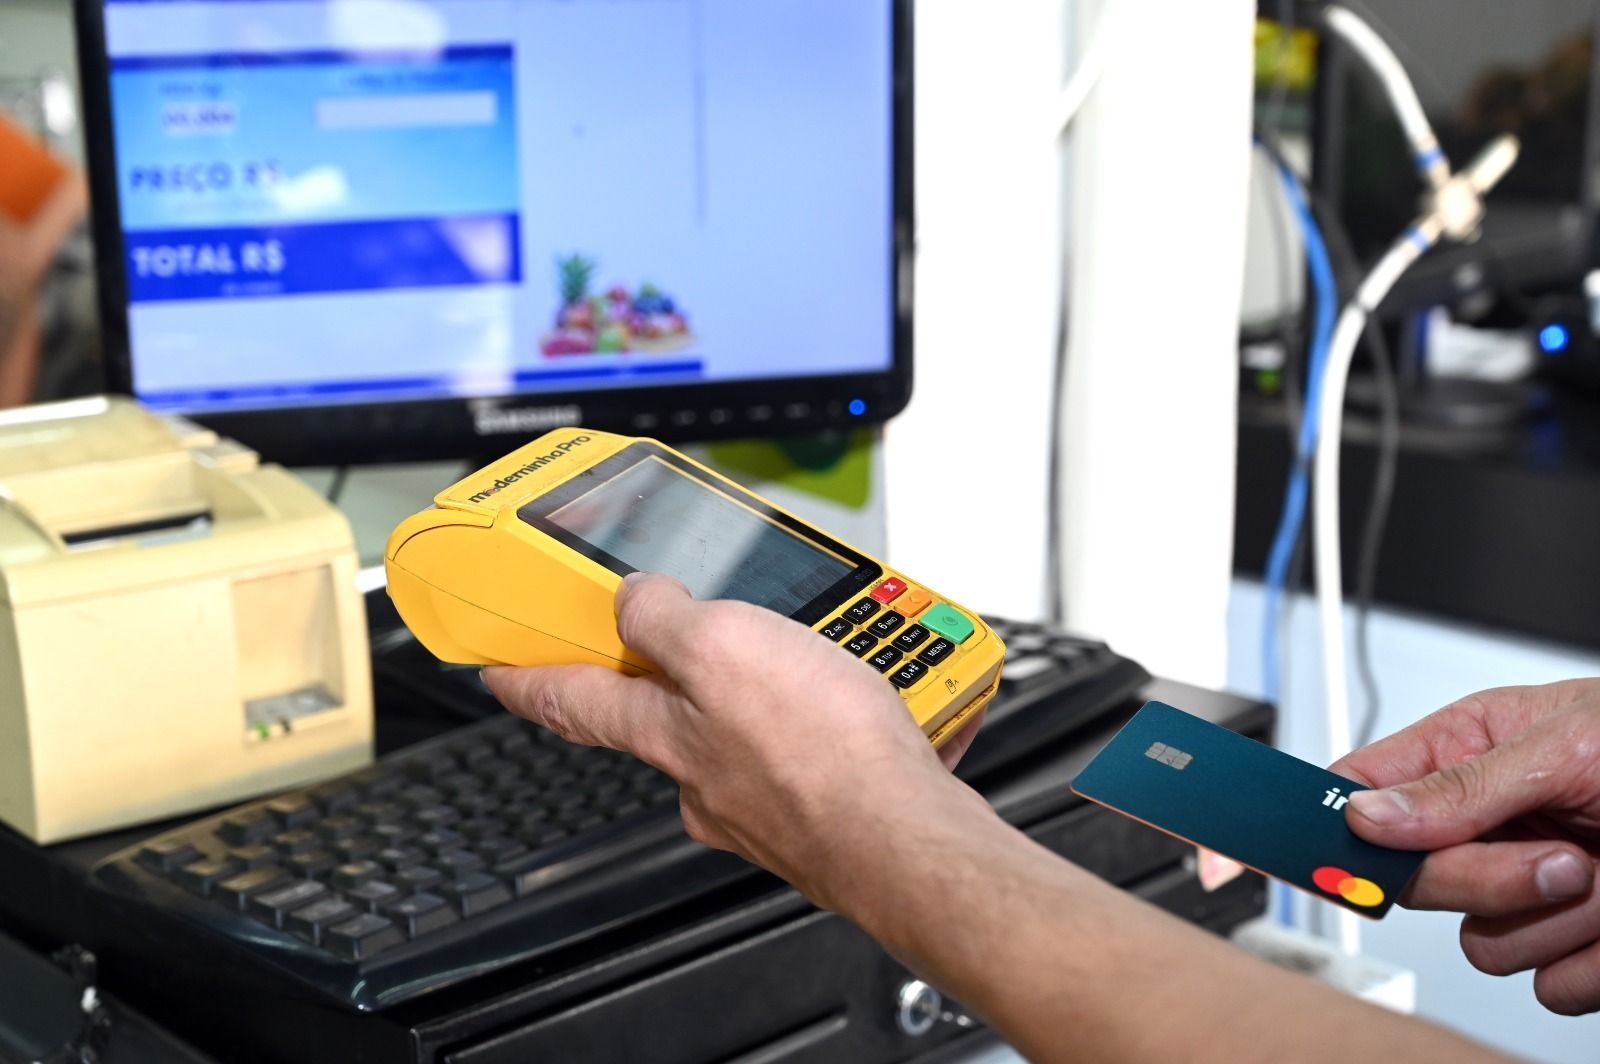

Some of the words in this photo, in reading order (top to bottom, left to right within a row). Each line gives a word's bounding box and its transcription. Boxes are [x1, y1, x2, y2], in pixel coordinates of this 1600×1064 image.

[130, 162, 233, 193] PREÇO
[131, 243, 236, 278] TOTAL
[825, 629, 835, 637] 2
[902, 635, 912, 643] 9
[927, 641, 947, 657] MENU
[875, 657, 886, 665] 8
